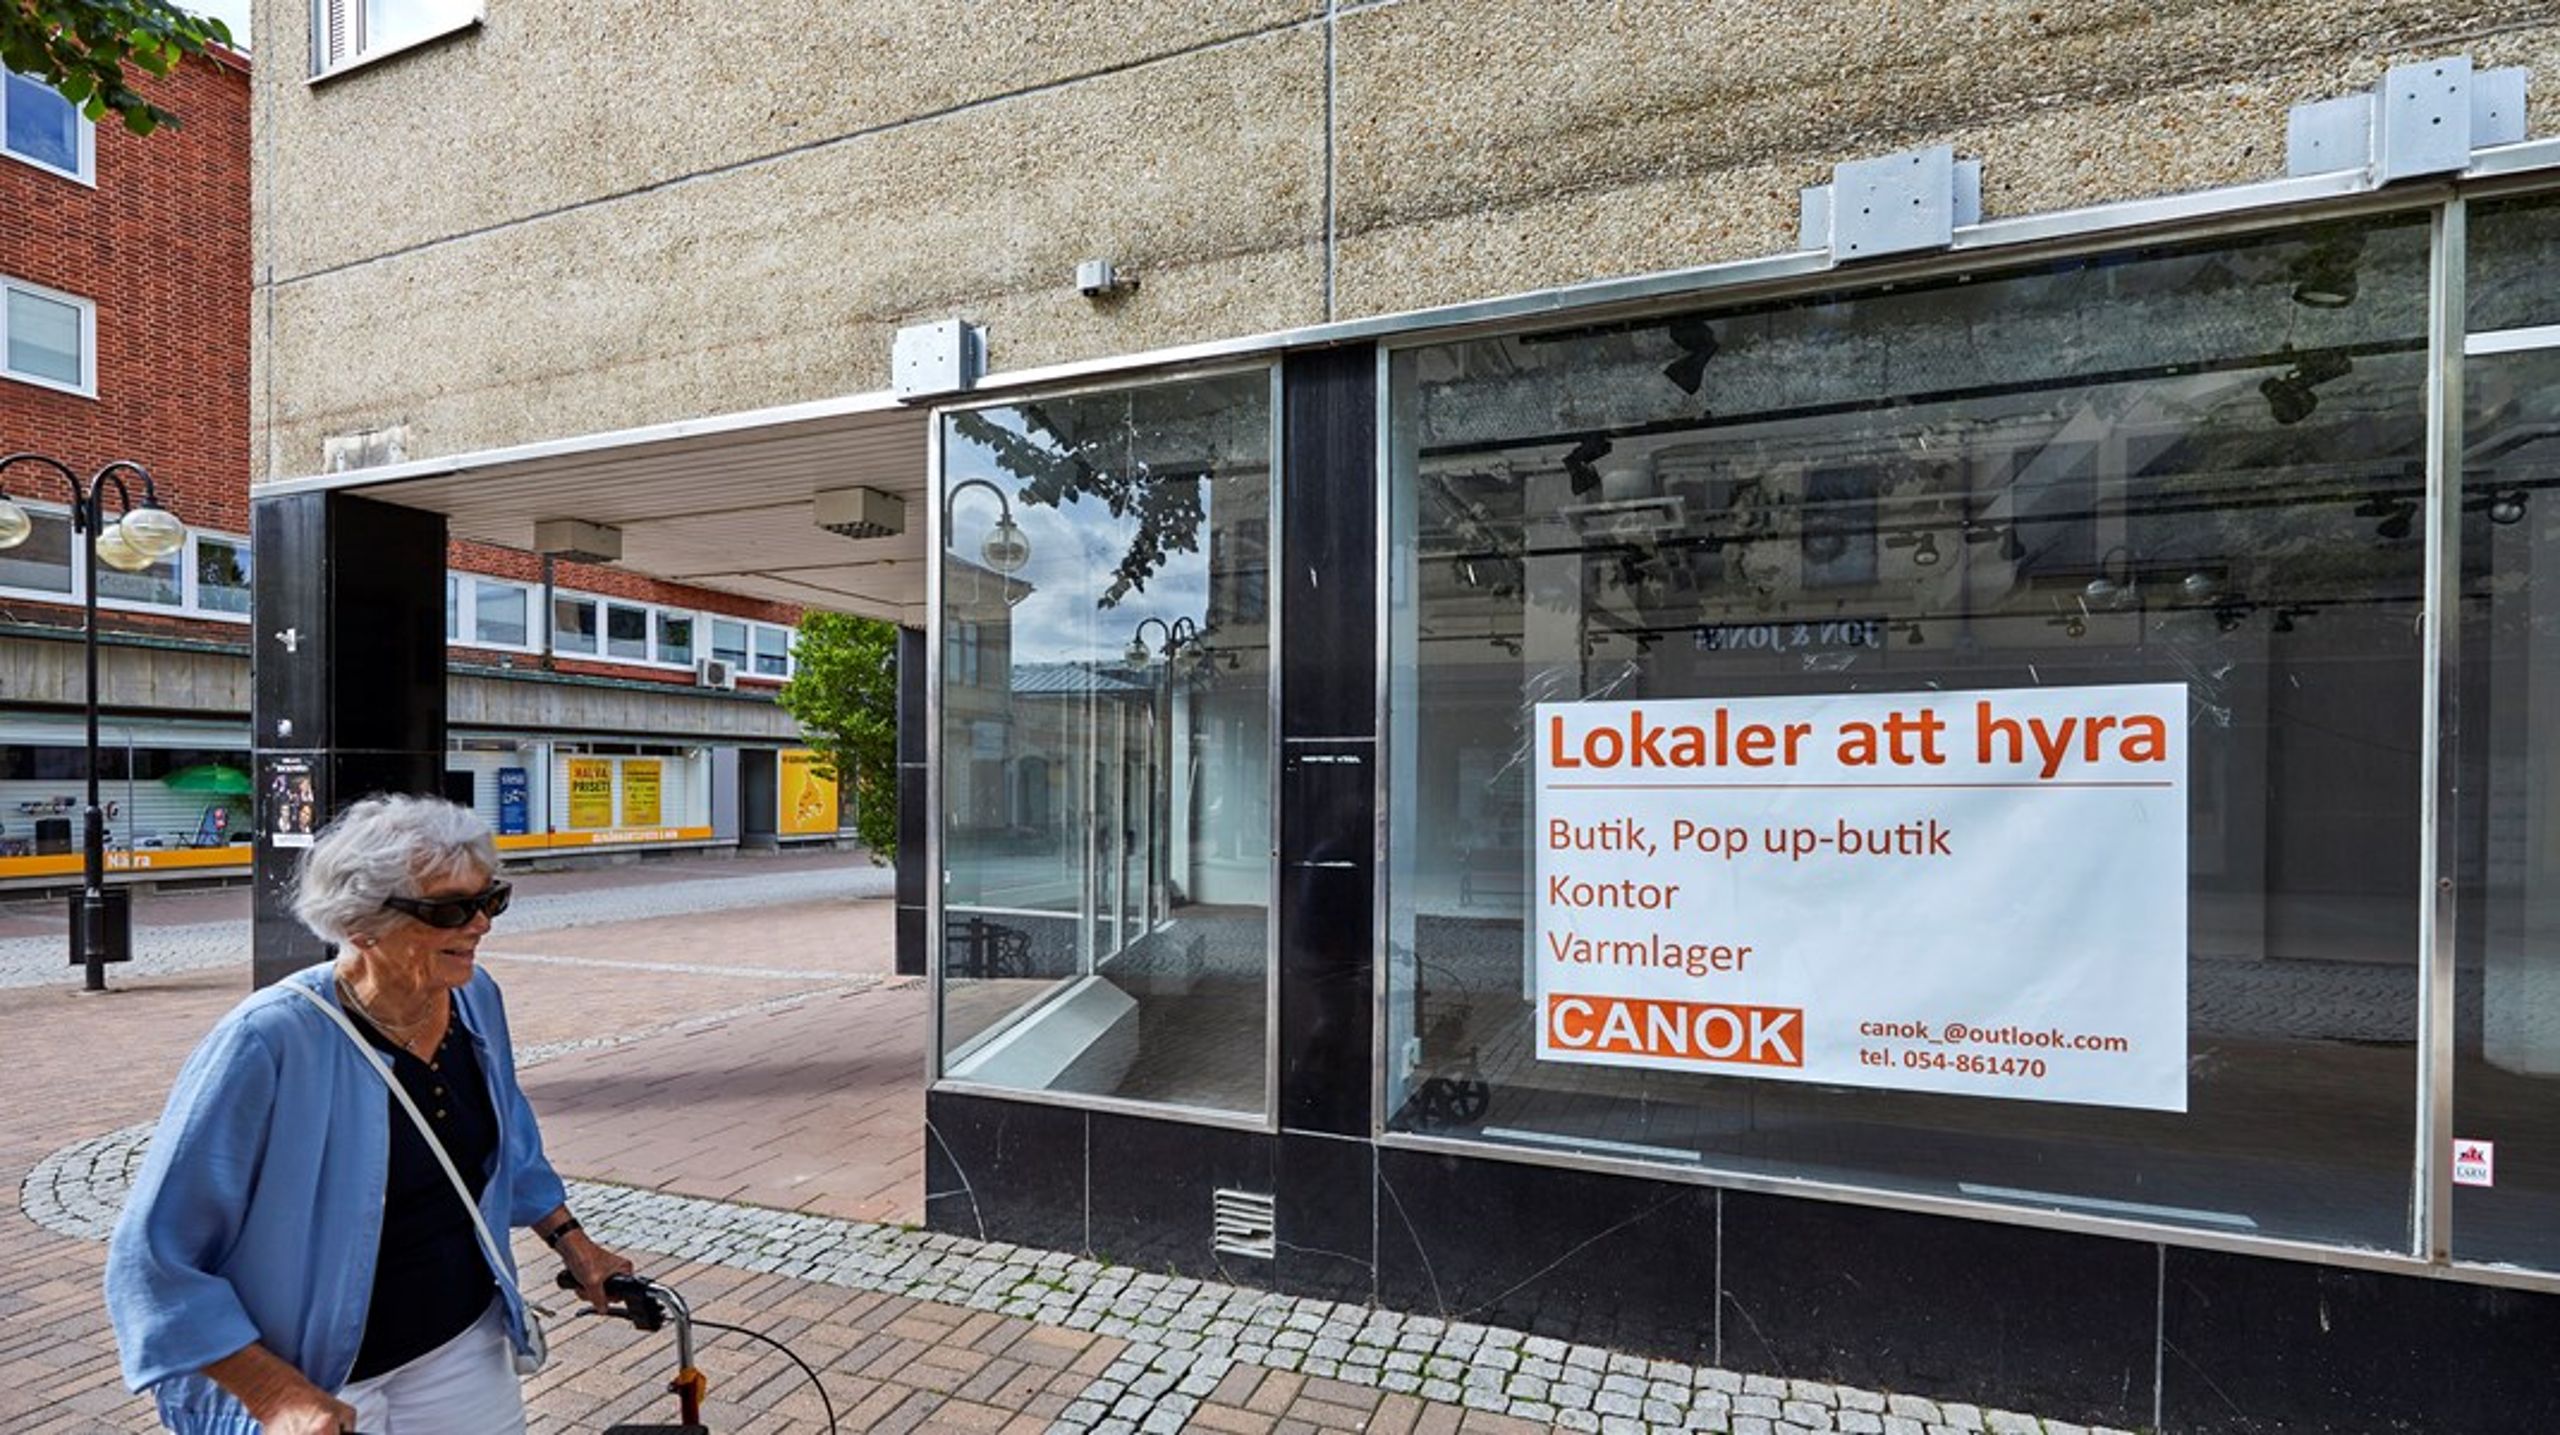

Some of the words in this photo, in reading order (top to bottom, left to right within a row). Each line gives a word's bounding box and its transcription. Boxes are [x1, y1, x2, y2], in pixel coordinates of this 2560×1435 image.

[1549, 707, 1813, 769] Lokaler
[1836, 708, 1947, 767] att
[1975, 699, 2168, 780] hyra
[1549, 818, 1657, 858] Butik,
[1671, 819, 1749, 860] Pop
[1764, 818, 1953, 862] up-butik
[1548, 875, 1680, 910] Kontor
[1547, 931, 1753, 977] Varmlager
[1550, 997, 1801, 1065] CANOK
[1859, 1017, 2129, 1053] canok_@outlook.com
[1859, 1048, 1898, 1070] tel.
[1903, 1050, 2048, 1079] 054-861470
